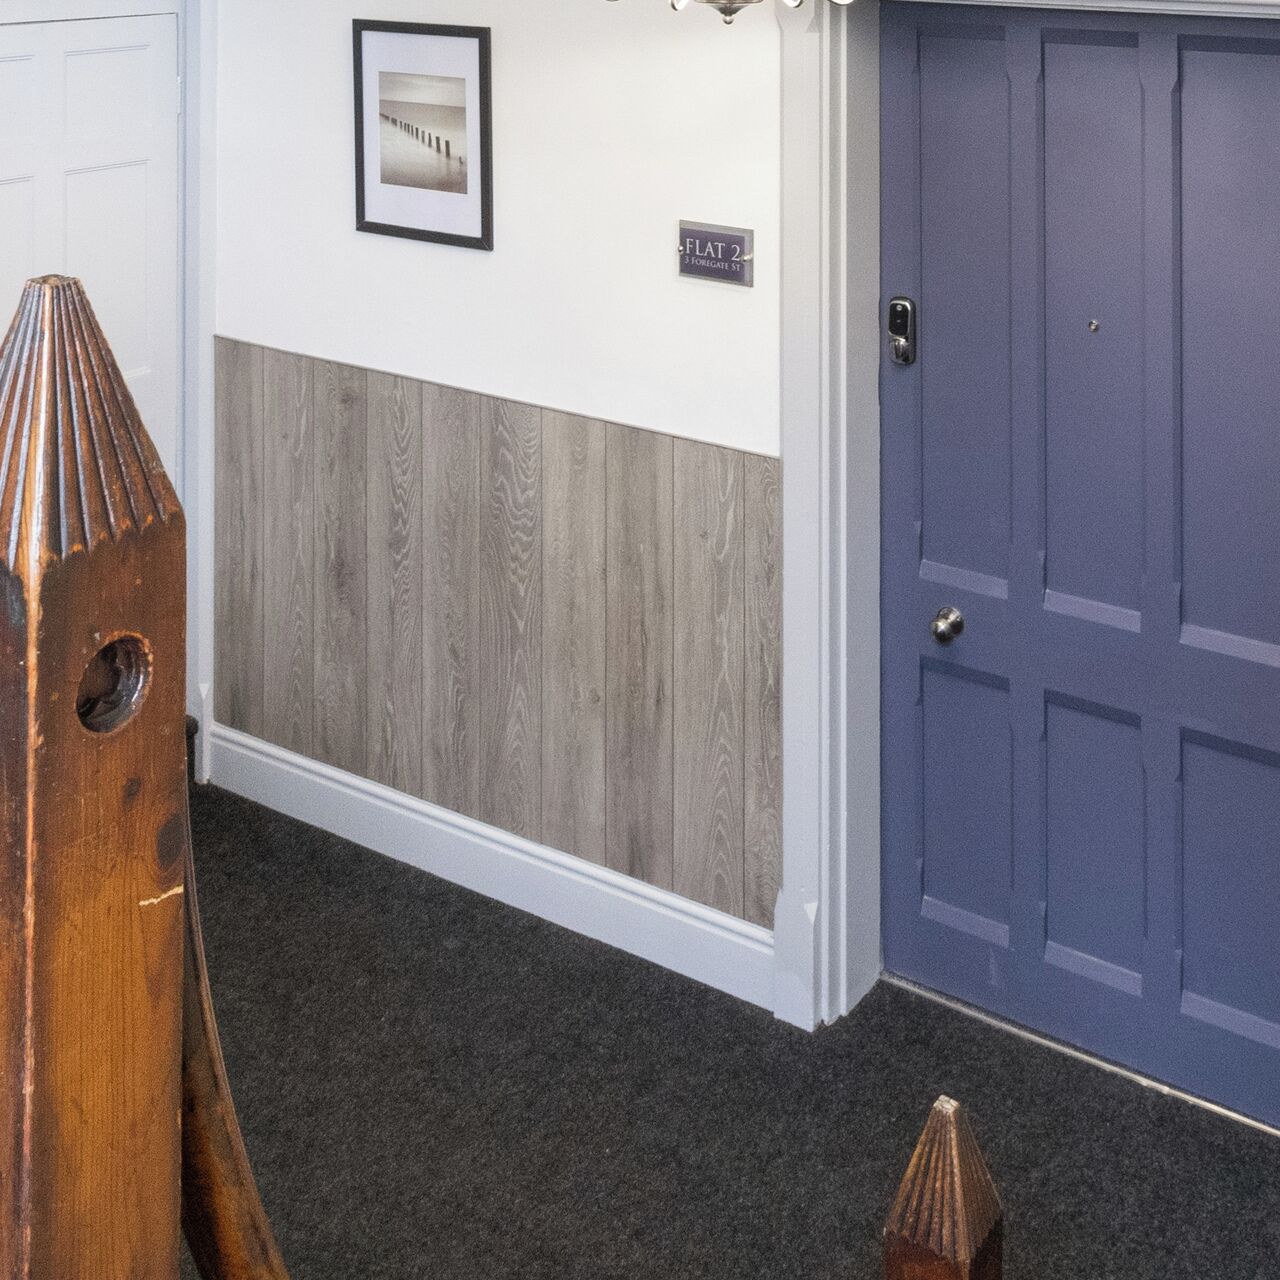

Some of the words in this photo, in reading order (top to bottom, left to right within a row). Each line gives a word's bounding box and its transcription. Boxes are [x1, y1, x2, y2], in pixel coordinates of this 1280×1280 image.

[686, 238, 725, 258] FLAT
[731, 244, 740, 261] 2
[691, 256, 729, 270] FOREGATE
